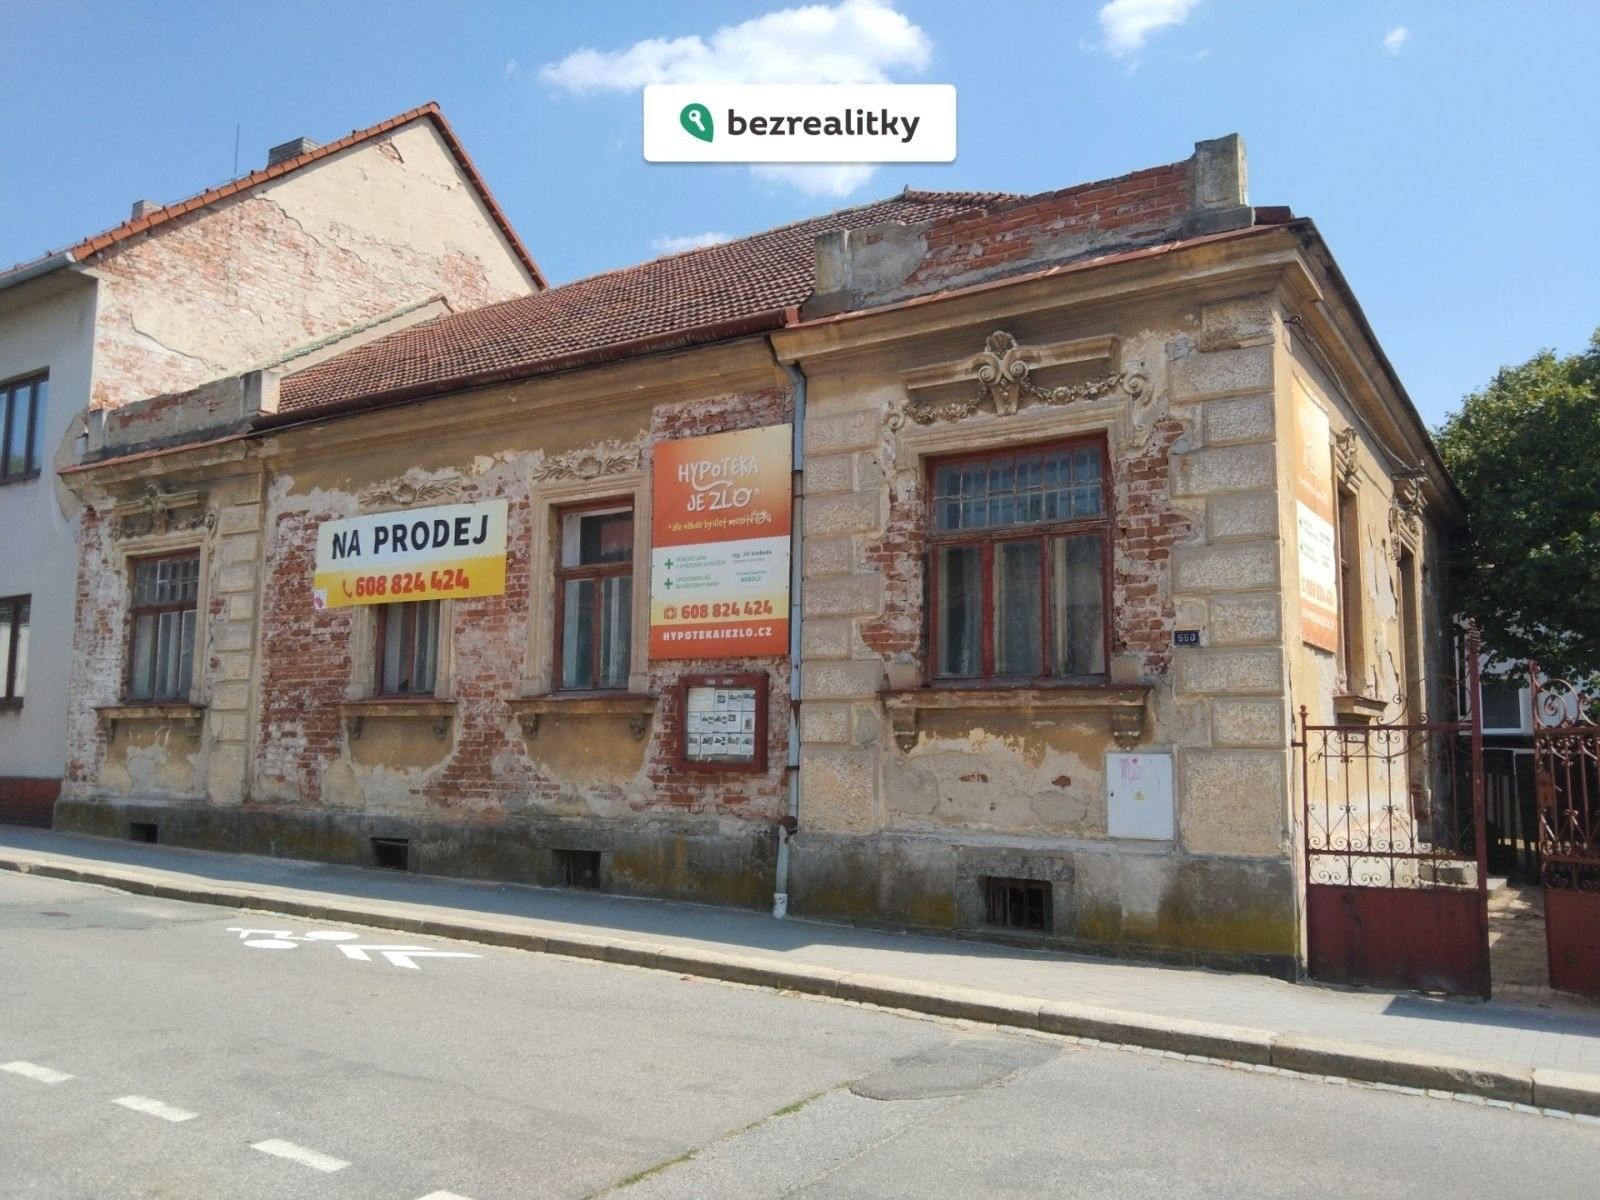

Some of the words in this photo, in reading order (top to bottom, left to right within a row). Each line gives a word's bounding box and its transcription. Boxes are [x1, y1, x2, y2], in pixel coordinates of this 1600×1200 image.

[687, 493, 705, 511] JE
[331, 529, 361, 560] NA
[373, 515, 489, 555] PRODEJ
[356, 575, 387, 597] 608
[391, 572, 426, 594] 824
[431, 568, 470, 591] 424
[681, 604, 709, 619] 608
[712, 602, 741, 618] 824
[743, 600, 773, 616] 424
[663, 626, 773, 641] HYPOTEKAJEZLO.CZ
